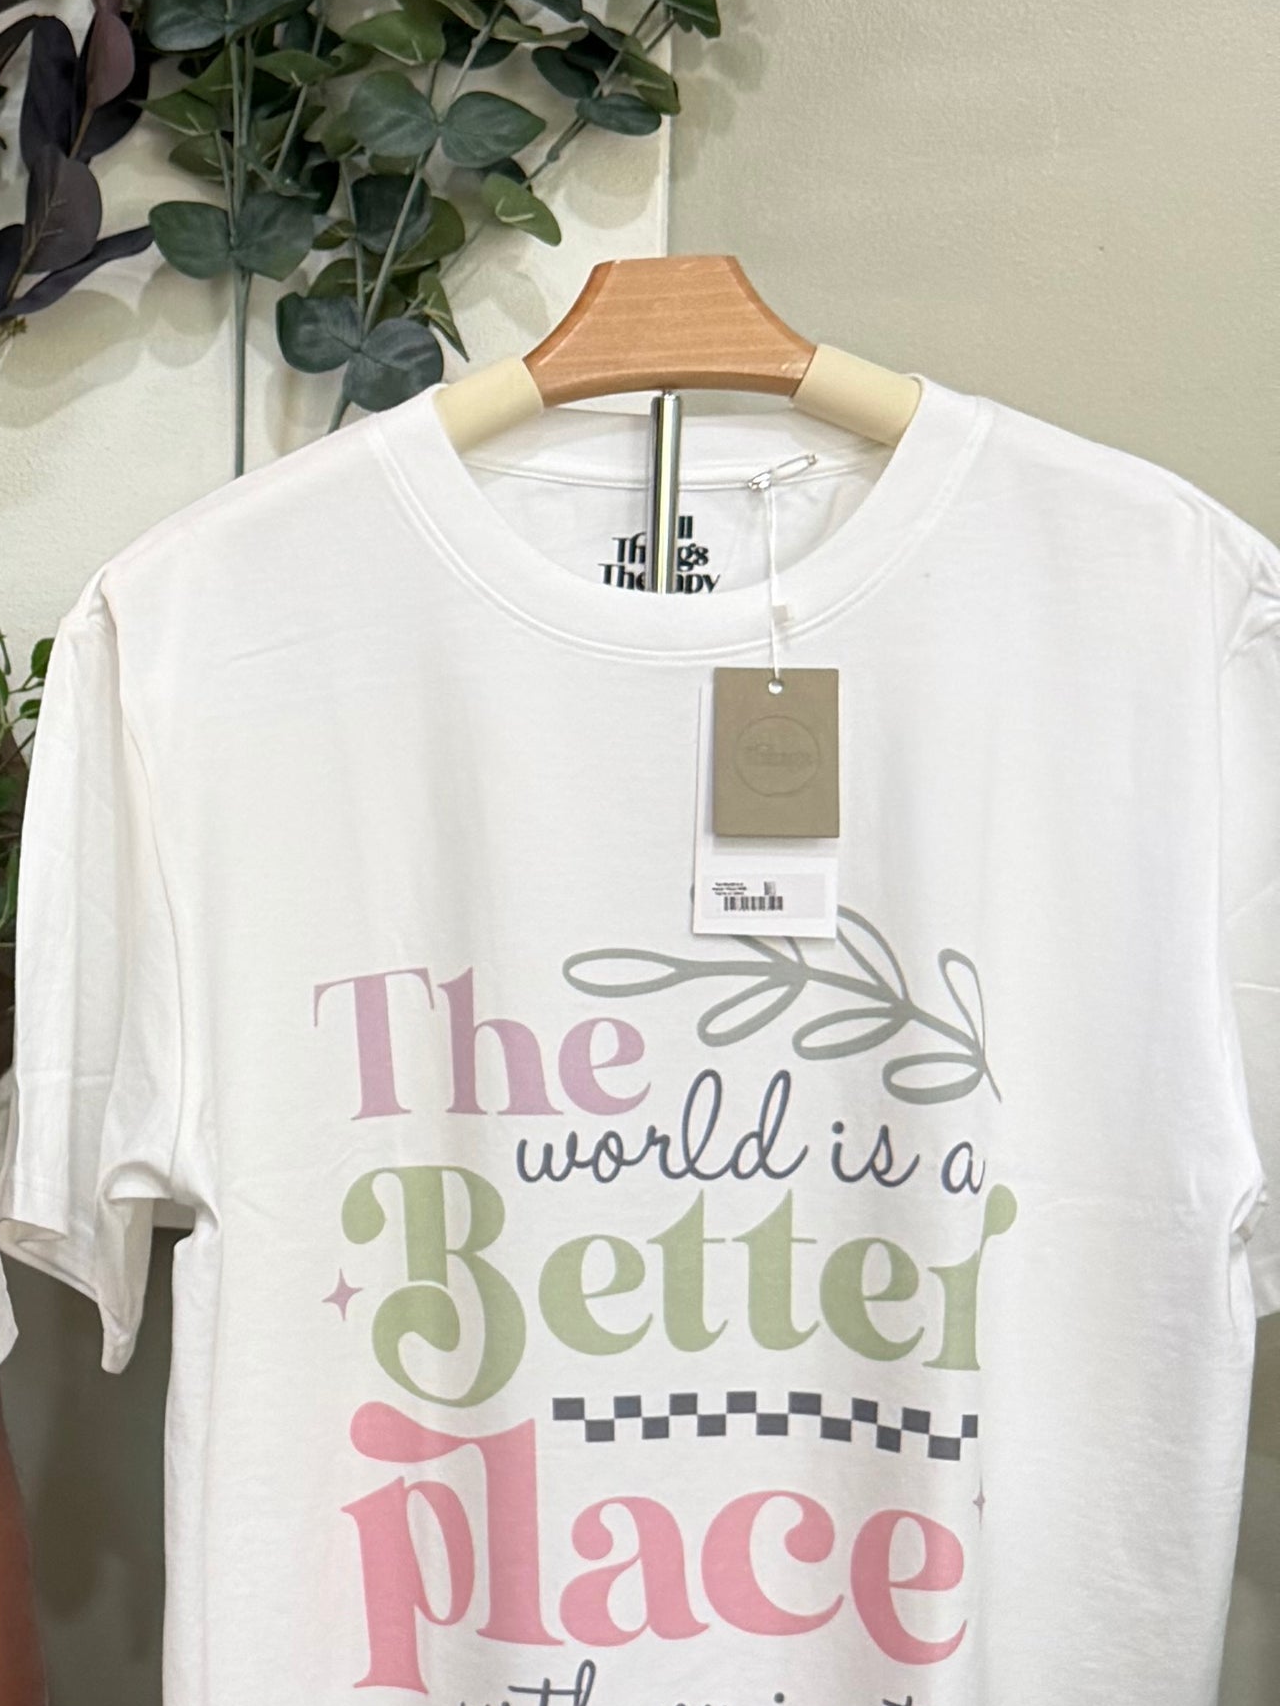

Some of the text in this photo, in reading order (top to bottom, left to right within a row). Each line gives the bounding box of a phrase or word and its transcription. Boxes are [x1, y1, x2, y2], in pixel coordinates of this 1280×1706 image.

[611, 531, 710, 573] Thgs
[313, 966, 652, 1122] The
[516, 1068, 986, 1195] world is a
[340, 1164, 1019, 1409] Better
[340, 1400, 969, 1696] place
